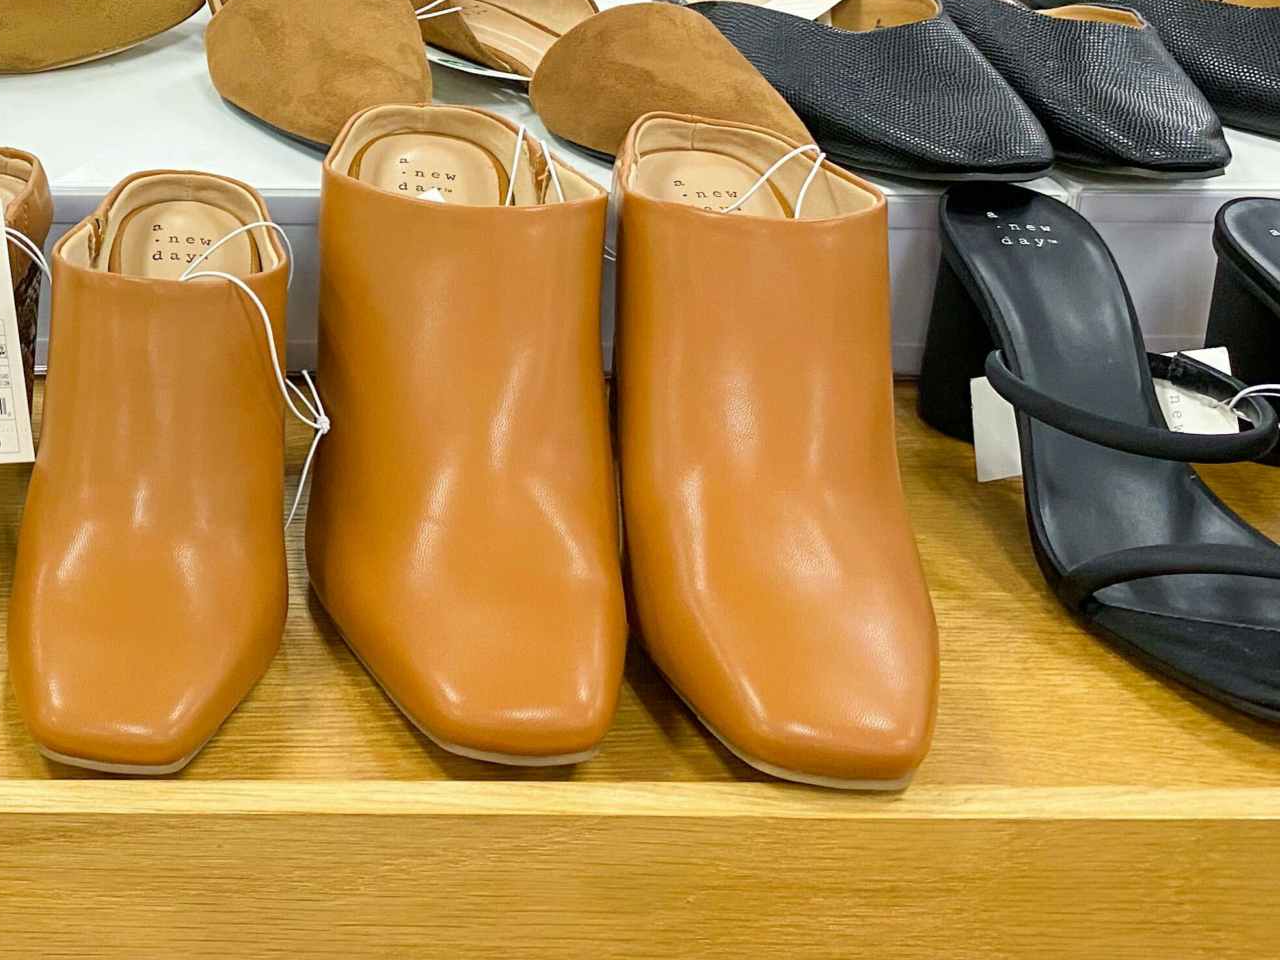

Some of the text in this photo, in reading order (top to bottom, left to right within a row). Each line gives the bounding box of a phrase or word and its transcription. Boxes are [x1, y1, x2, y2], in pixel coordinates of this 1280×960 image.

[414, 168, 457, 182] new
[695, 190, 738, 199] new
[986, 211, 999, 219] a
[152, 223, 163, 232] a
[1008, 223, 1051, 232] new
[168, 235, 212, 246] new
